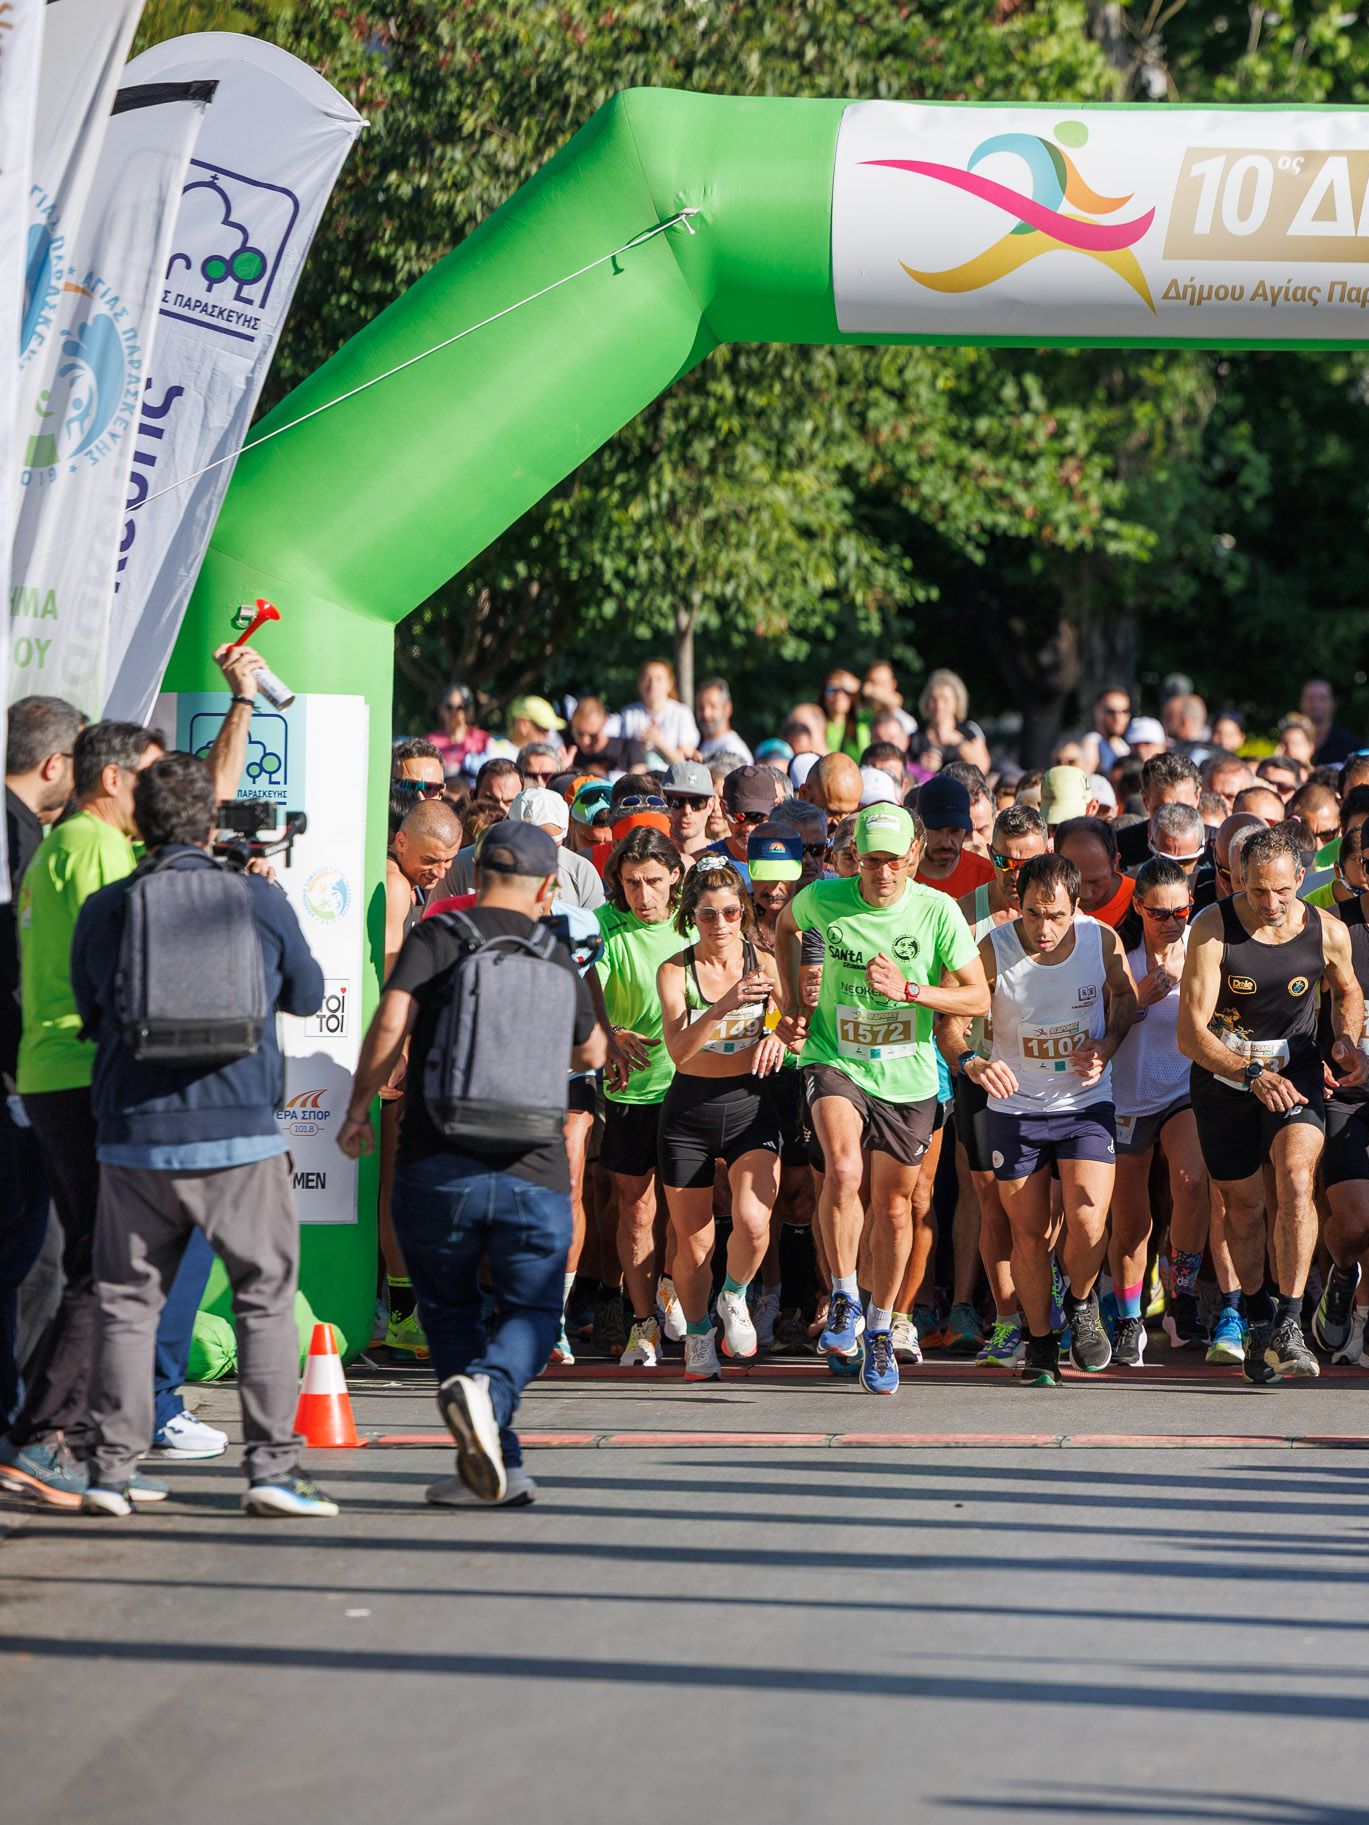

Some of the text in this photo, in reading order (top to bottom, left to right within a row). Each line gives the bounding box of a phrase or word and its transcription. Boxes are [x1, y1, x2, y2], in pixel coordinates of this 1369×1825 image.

[1161, 277, 1244, 306] Δήμου
[1250, 278, 1321, 307] Αγίας
[173, 293, 261, 330] ΠΑΡΑΣΚΕΥΗΣ
[83, 271, 142, 466] ΑΓΙΑΣ ΠΑΡΑΣΚΕΥΗΣ
[21, 466, 57, 487] 019
[14, 636, 52, 669] ΟΥ
[237, 789, 288, 799] ΠΑΡΑΣΚΕΥΗΣ
[320, 994, 345, 1013] OI
[316, 1014, 344, 1033] TOI
[716, 1018, 760, 1039] 149
[843, 1022, 905, 1043] 1572
[276, 1110, 331, 1120] ΕΡΑ ΣΠΟΡ
